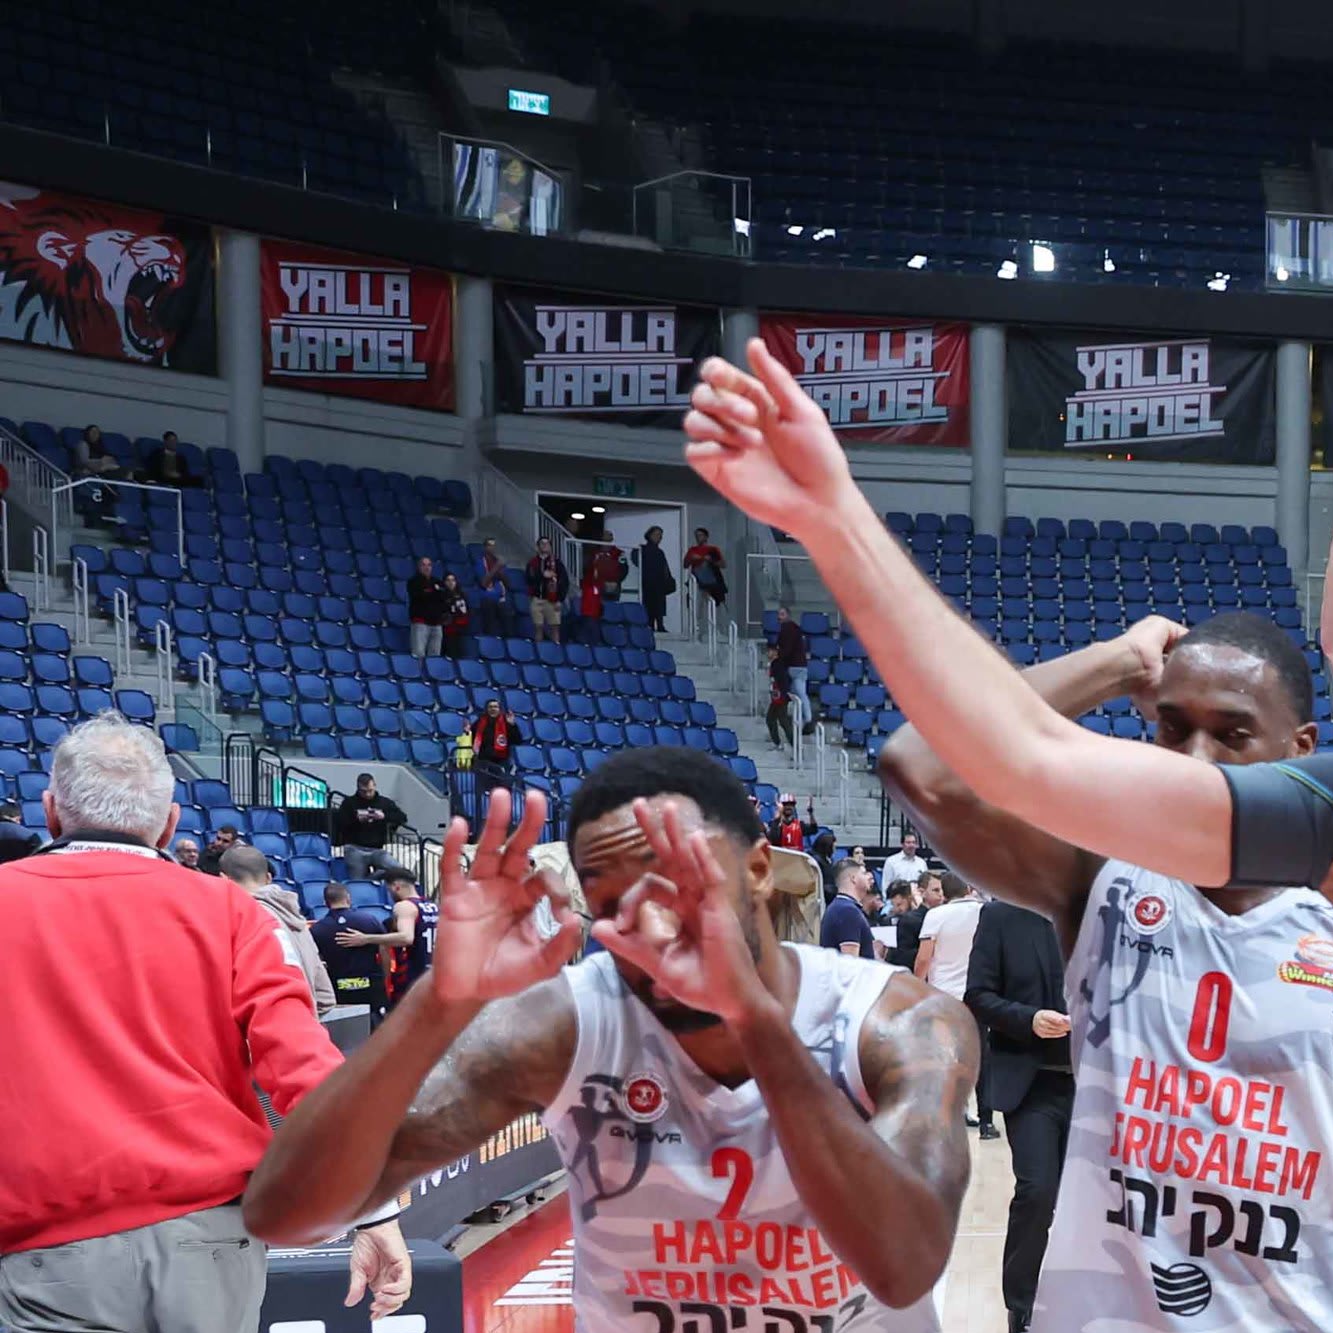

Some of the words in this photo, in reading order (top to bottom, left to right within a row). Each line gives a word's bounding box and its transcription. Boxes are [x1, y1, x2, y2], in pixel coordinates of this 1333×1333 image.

[280, 268, 410, 317] YALLA
[270, 327, 426, 374] HAPOEL
[536, 309, 676, 355] YALLA
[797, 330, 934, 374] YALLA
[524, 362, 693, 408] HAPOEL
[1076, 343, 1209, 390] YALLA
[804, 378, 948, 425] APOEL
[1066, 390, 1224, 442] HAPOEL
[1187, 970, 1233, 1063] 0
[1123, 1056, 1289, 1136] HAPOEL
[1109, 1112, 1322, 1200] RUSALEM
[711, 1146, 755, 1220] 2
[652, 1219, 835, 1273] HAPOEL
[1188, 1192, 1302, 1264] בנק
